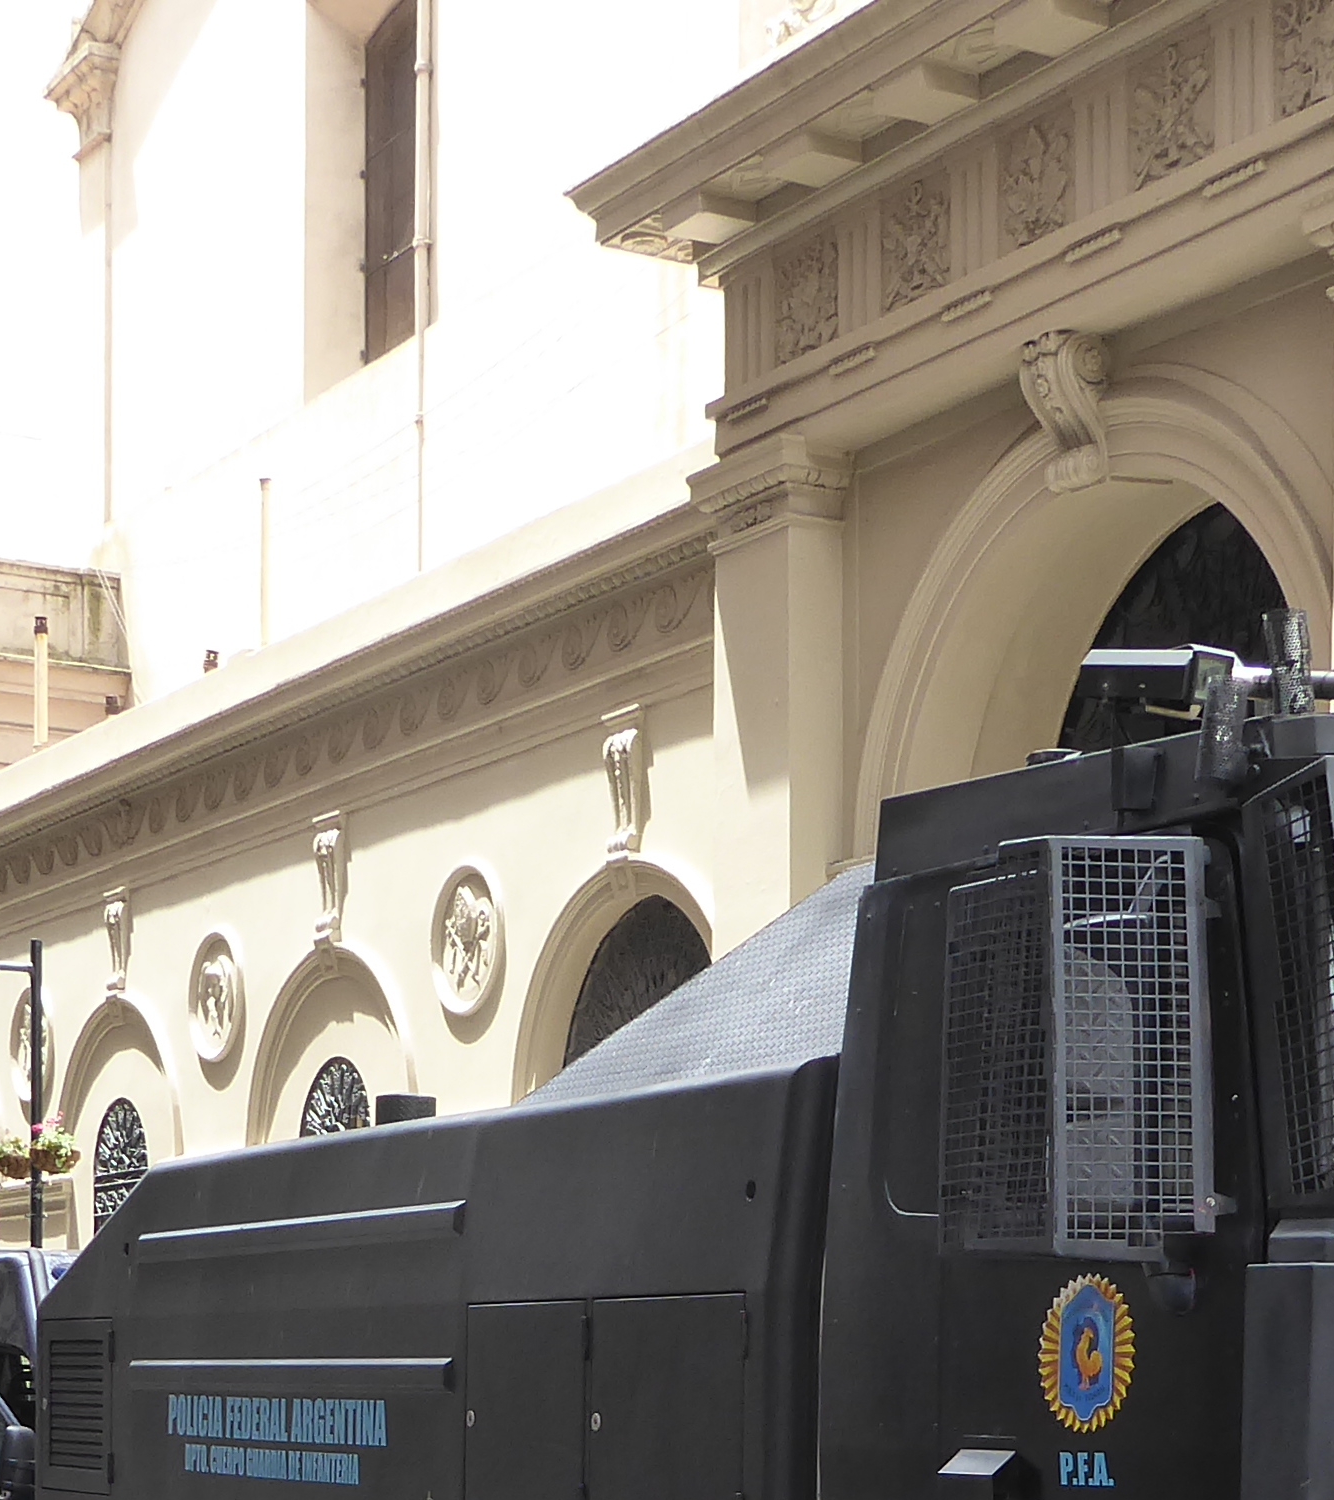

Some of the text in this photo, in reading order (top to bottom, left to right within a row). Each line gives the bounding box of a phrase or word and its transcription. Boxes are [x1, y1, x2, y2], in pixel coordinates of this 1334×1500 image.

[168, 1394, 387, 1446] POLICIA FEDERAL ARGENTINA
[210, 1444, 245, 1476] CUERPO
[288, 1450, 302, 1481] DE
[302, 1451, 360, 1485] INFANTERIA
[1058, 1451, 1115, 1487] P.F.A.
